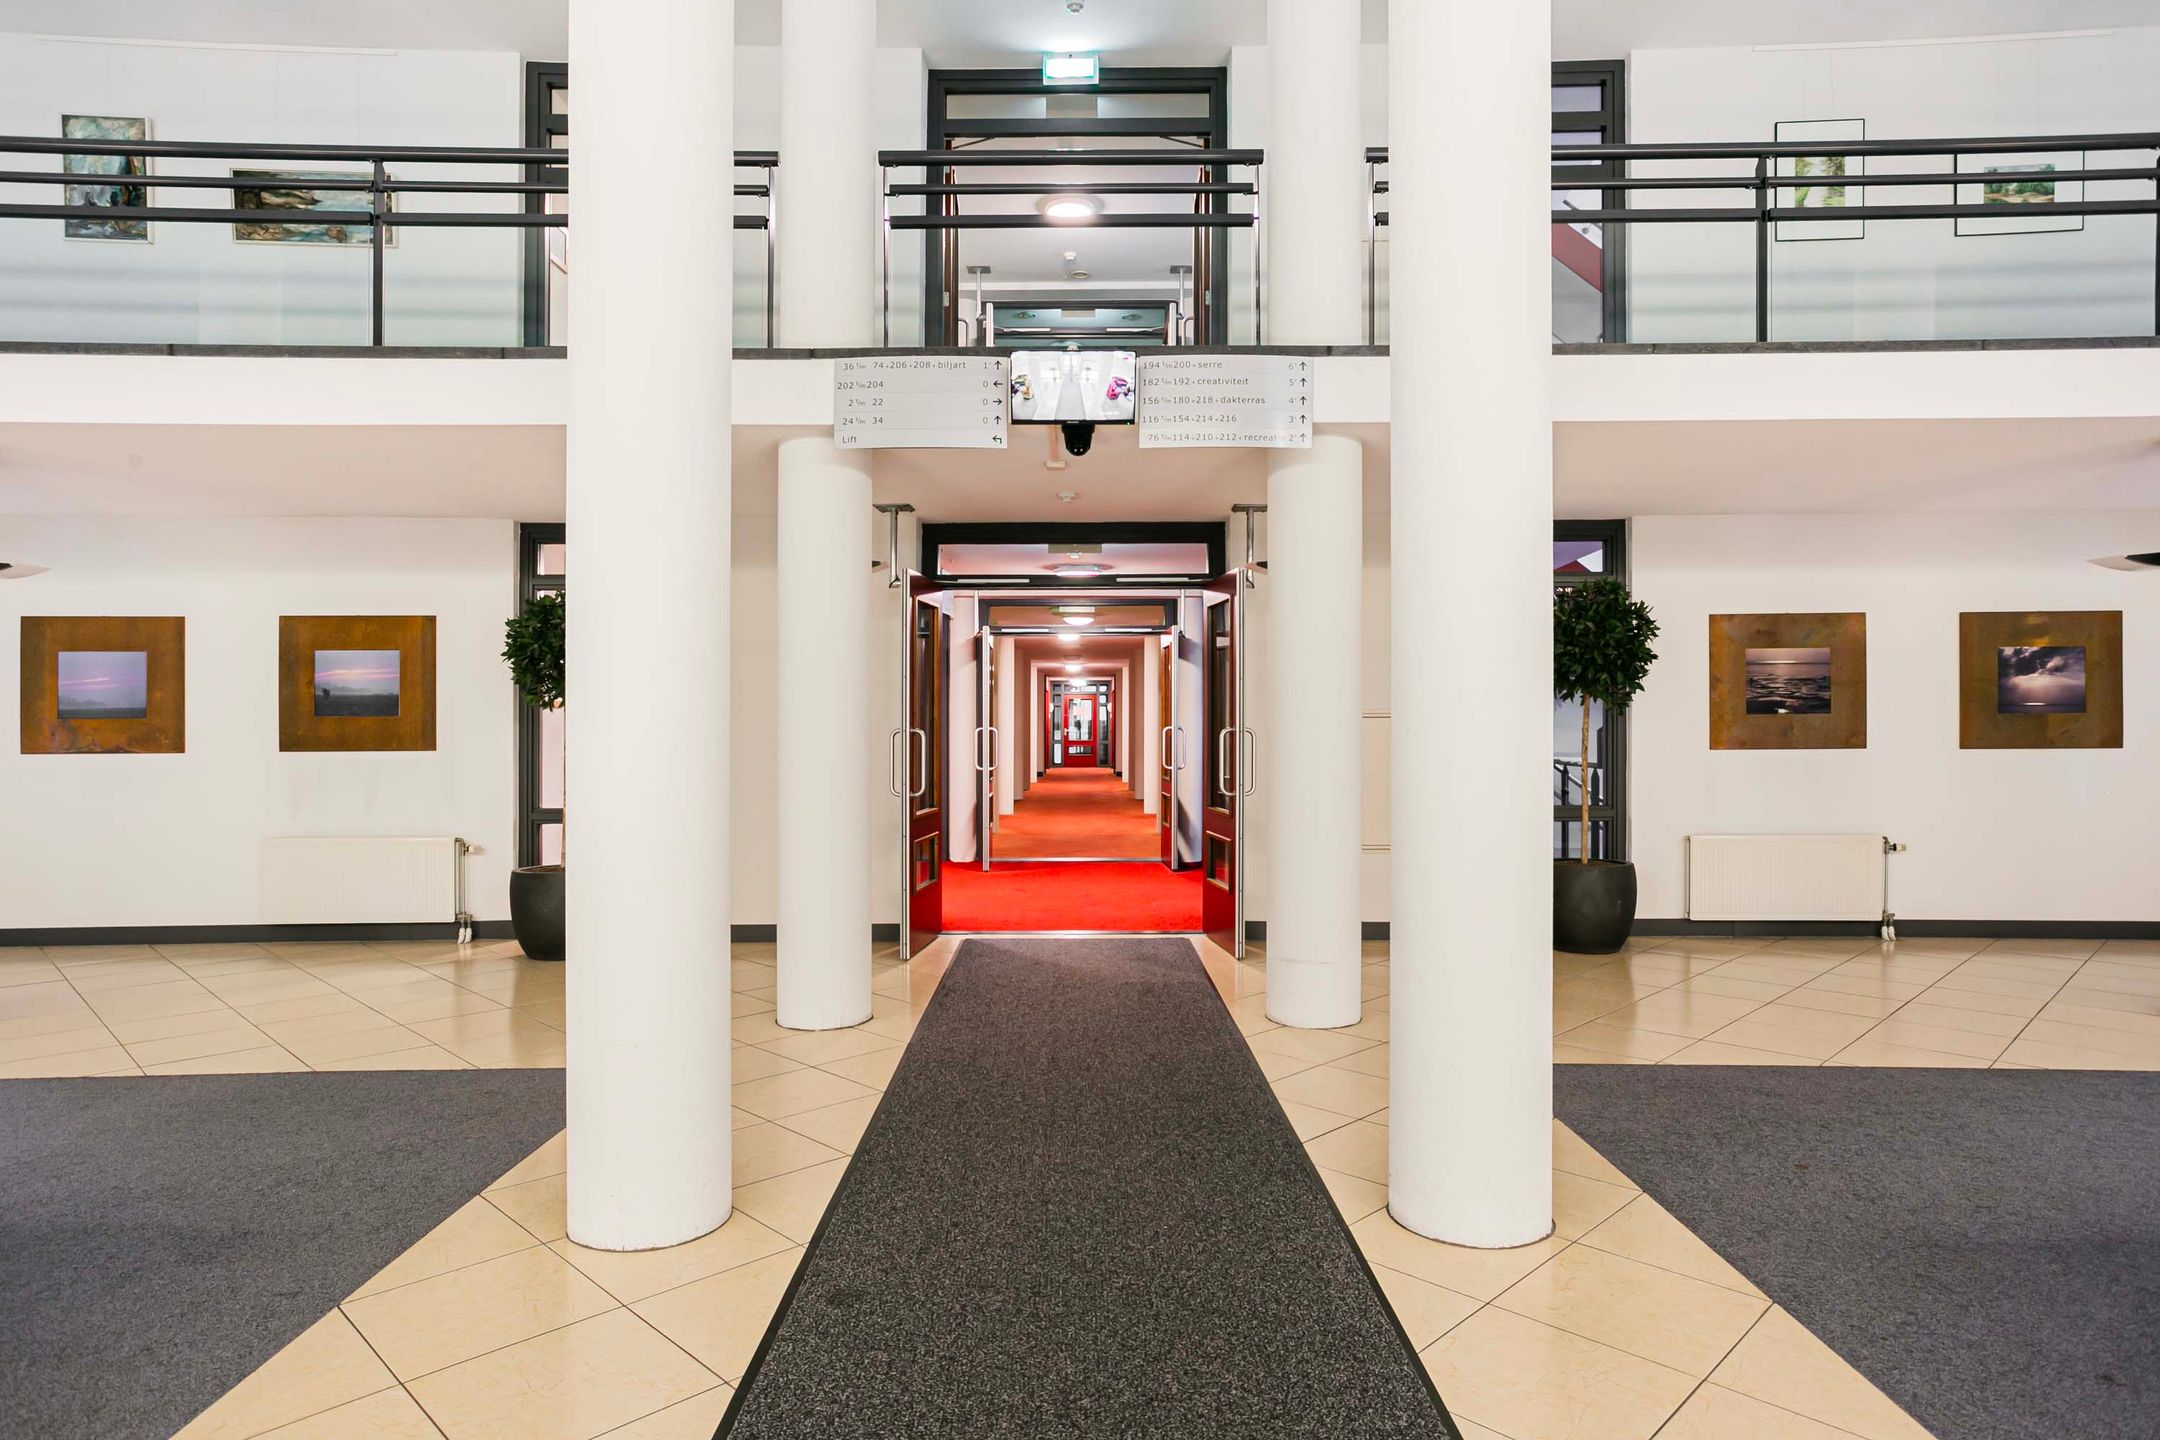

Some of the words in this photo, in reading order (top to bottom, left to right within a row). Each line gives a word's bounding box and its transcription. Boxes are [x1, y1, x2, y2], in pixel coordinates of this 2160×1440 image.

[890, 361, 907, 369] 206
[913, 361, 931, 369] 208
[938, 361, 966, 370] biljart
[1143, 362, 1160, 370] 194
[1173, 361, 1191, 369] 200
[1197, 377, 1249, 385] creativiteit
[872, 398, 884, 406] 22
[1173, 396, 1190, 404] 180
[1196, 396, 1214, 404] 218
[1220, 396, 1266, 404] dakterras
[872, 416, 884, 424] 34
[1173, 414, 1190, 422] 154
[1196, 414, 1213, 422] 214
[1220, 414, 1238, 422] 216
[842, 435, 857, 444] Lift
[1196, 433, 1214, 441] 210
[1220, 433, 1238, 441] 212
